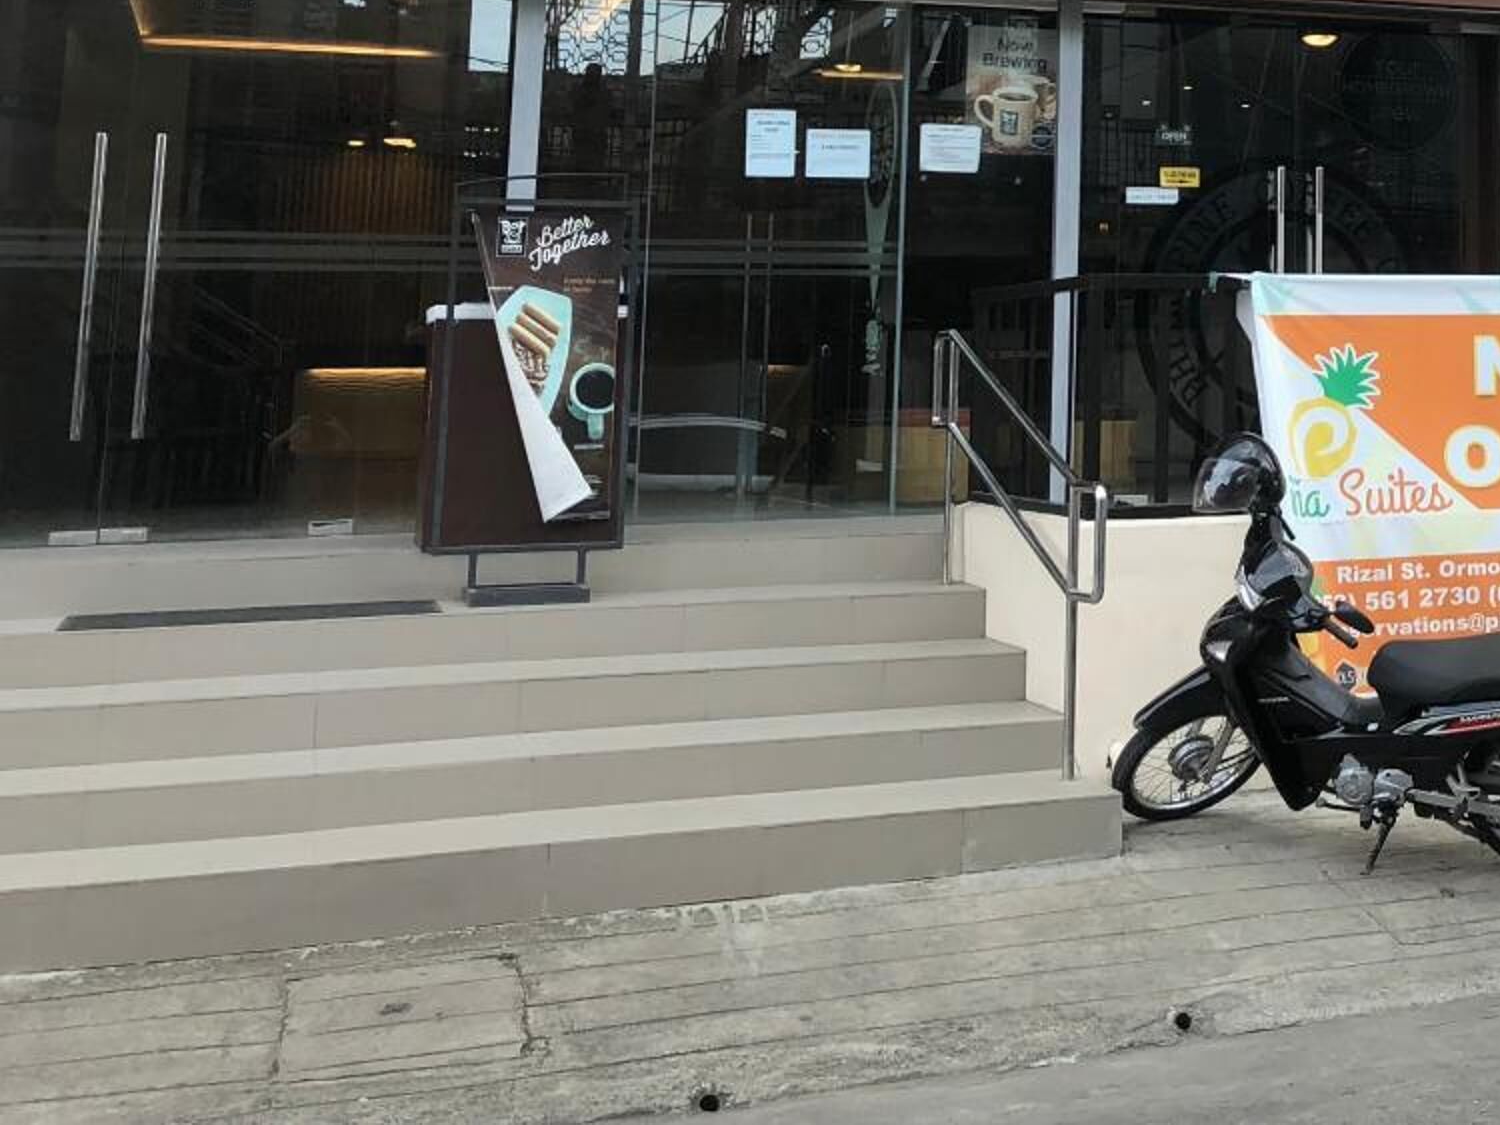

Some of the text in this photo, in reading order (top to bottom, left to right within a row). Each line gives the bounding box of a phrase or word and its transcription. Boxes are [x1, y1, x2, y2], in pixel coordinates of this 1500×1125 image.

[982, 53, 1048, 75] Brewing
[537, 215, 593, 247] Better
[528, 231, 610, 271] Together
[1338, 466, 1454, 517] Suites
[1336, 564, 1393, 584] Rizal
[1401, 561, 1431, 580] St.
[1365, 589, 1410, 611] 561
[1418, 585, 1481, 609] 2730
